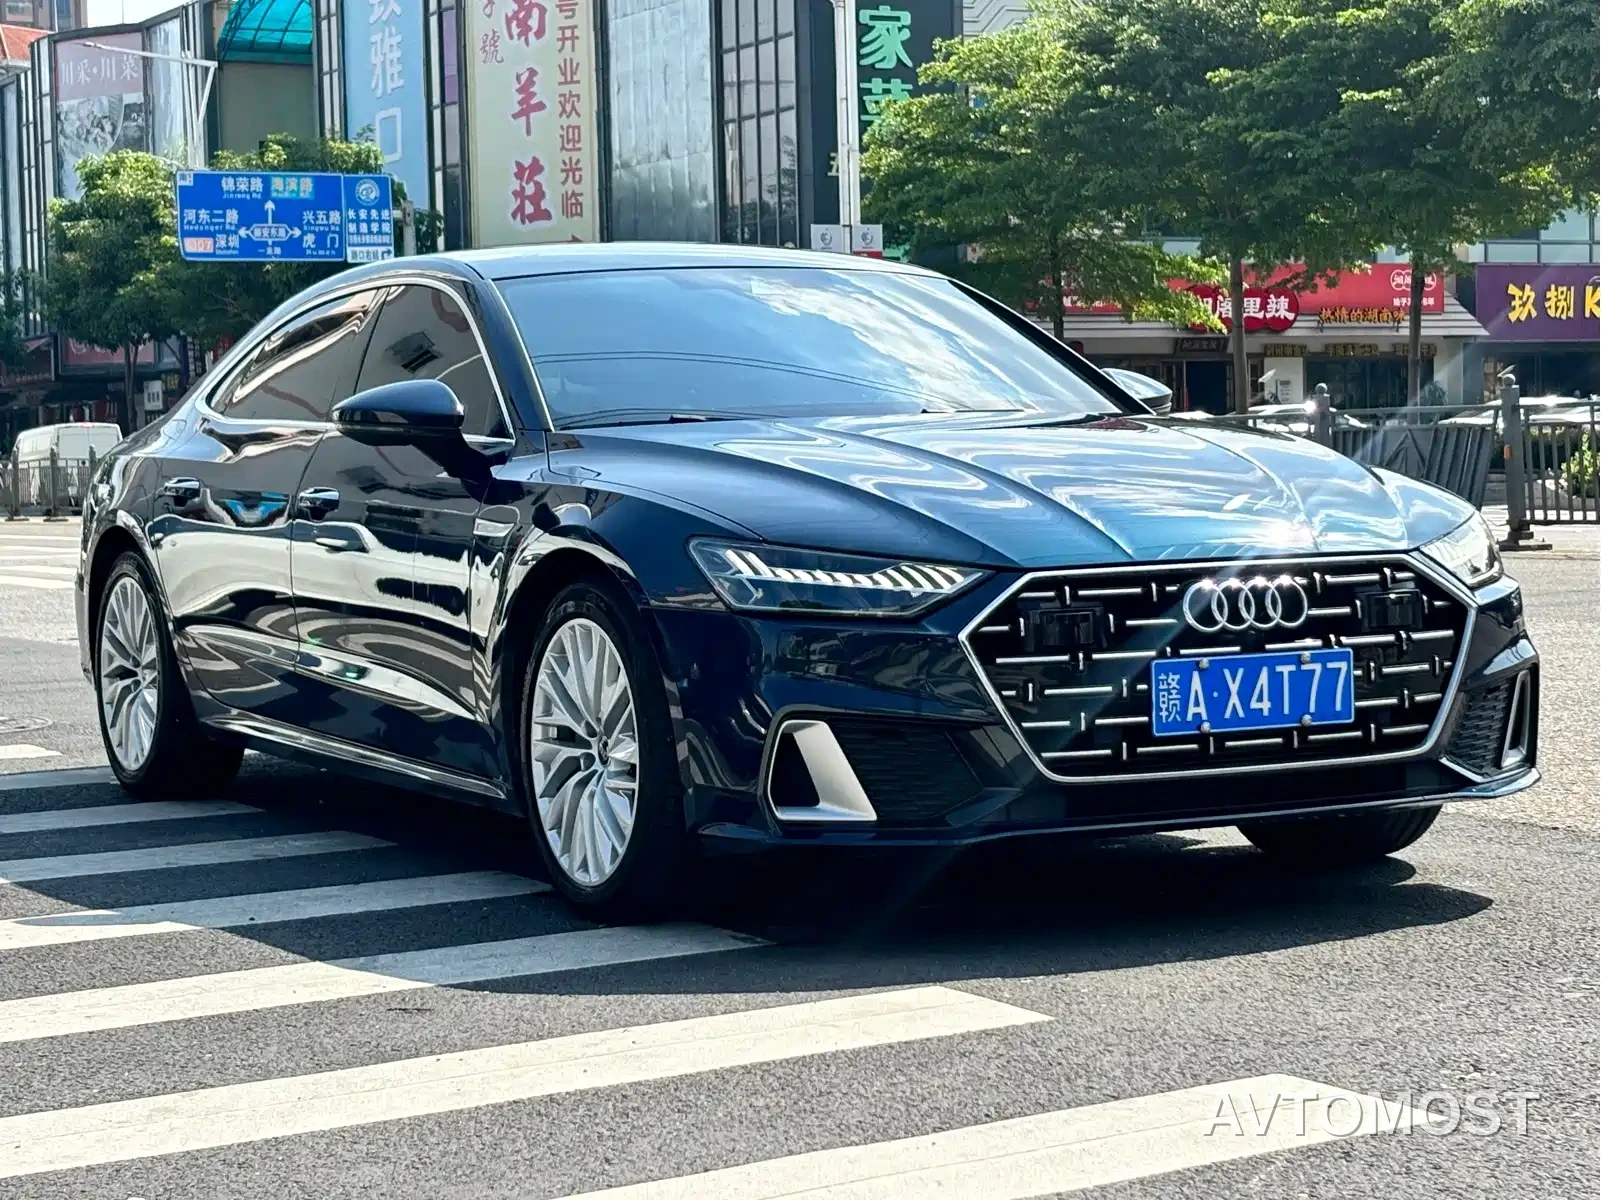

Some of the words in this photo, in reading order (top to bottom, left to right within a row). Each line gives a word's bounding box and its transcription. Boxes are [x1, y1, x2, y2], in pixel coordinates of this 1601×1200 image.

[221, 176, 264, 192] 锦荣路
[183, 208, 239, 225] 河东二路
[302, 210, 341, 225] 兴五路
[347, 208, 391, 220] 长安先进
[215, 233, 240, 249] 深圳
[302, 233, 339, 248] 虎门
